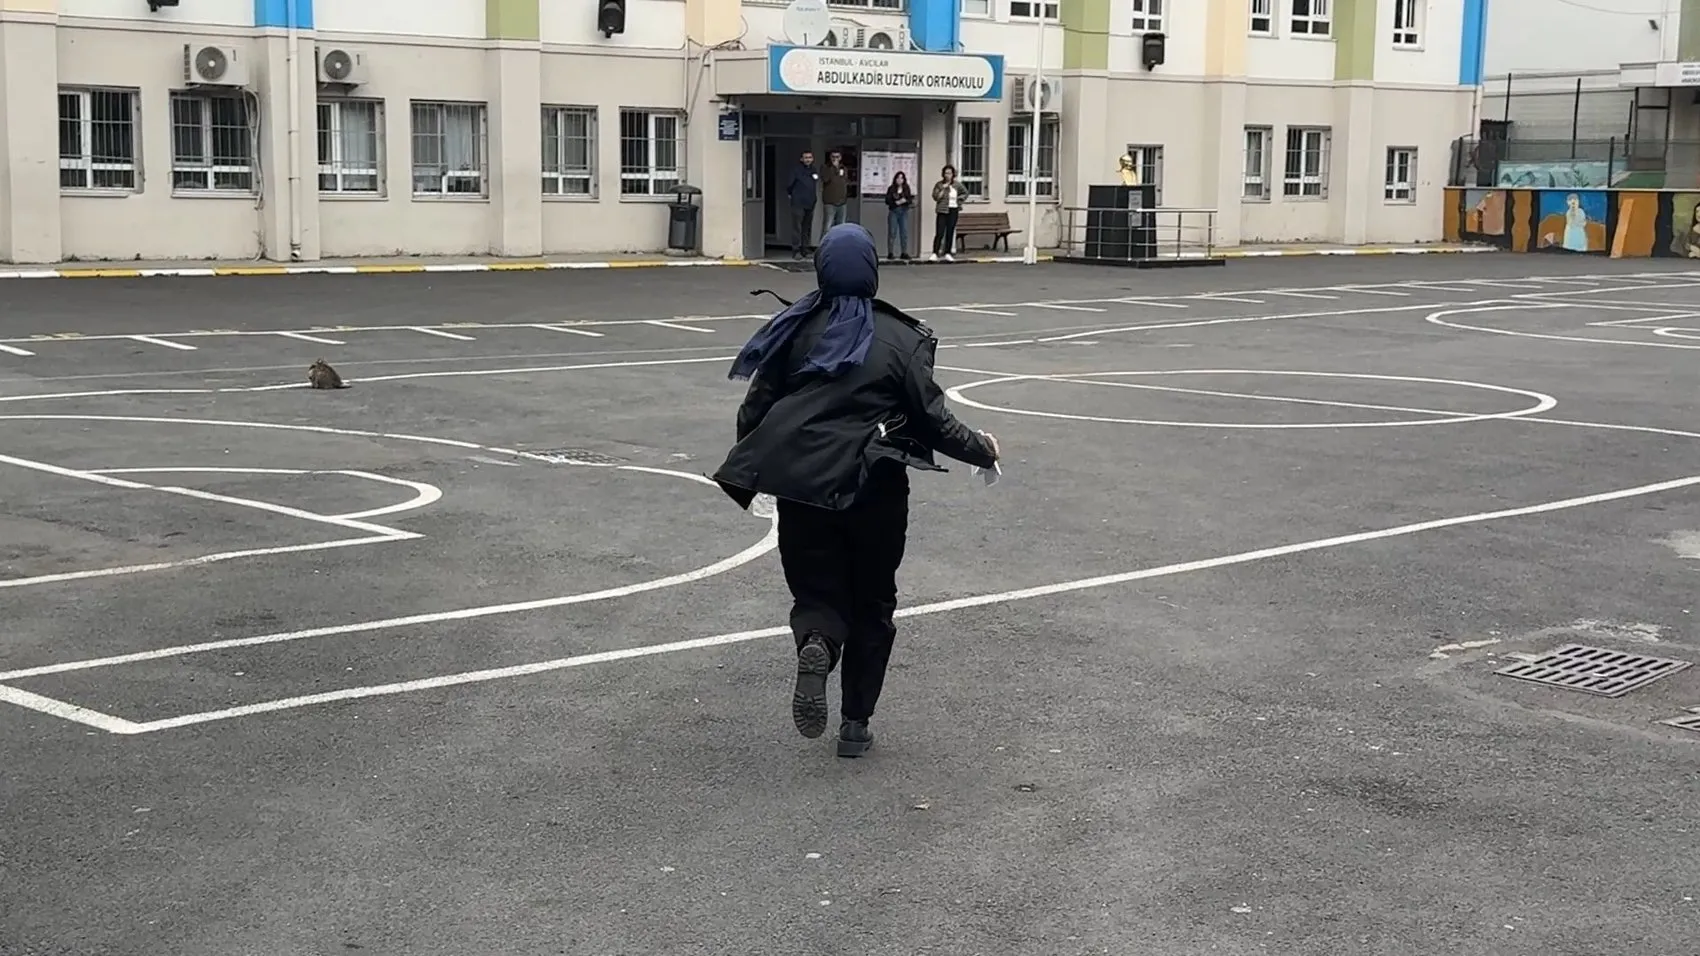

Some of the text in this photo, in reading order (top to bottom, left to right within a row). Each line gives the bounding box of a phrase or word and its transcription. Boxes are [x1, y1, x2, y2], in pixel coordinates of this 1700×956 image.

[817, 70, 984, 89] ABDULKADİR UZTÜRK ORTAOKULU
